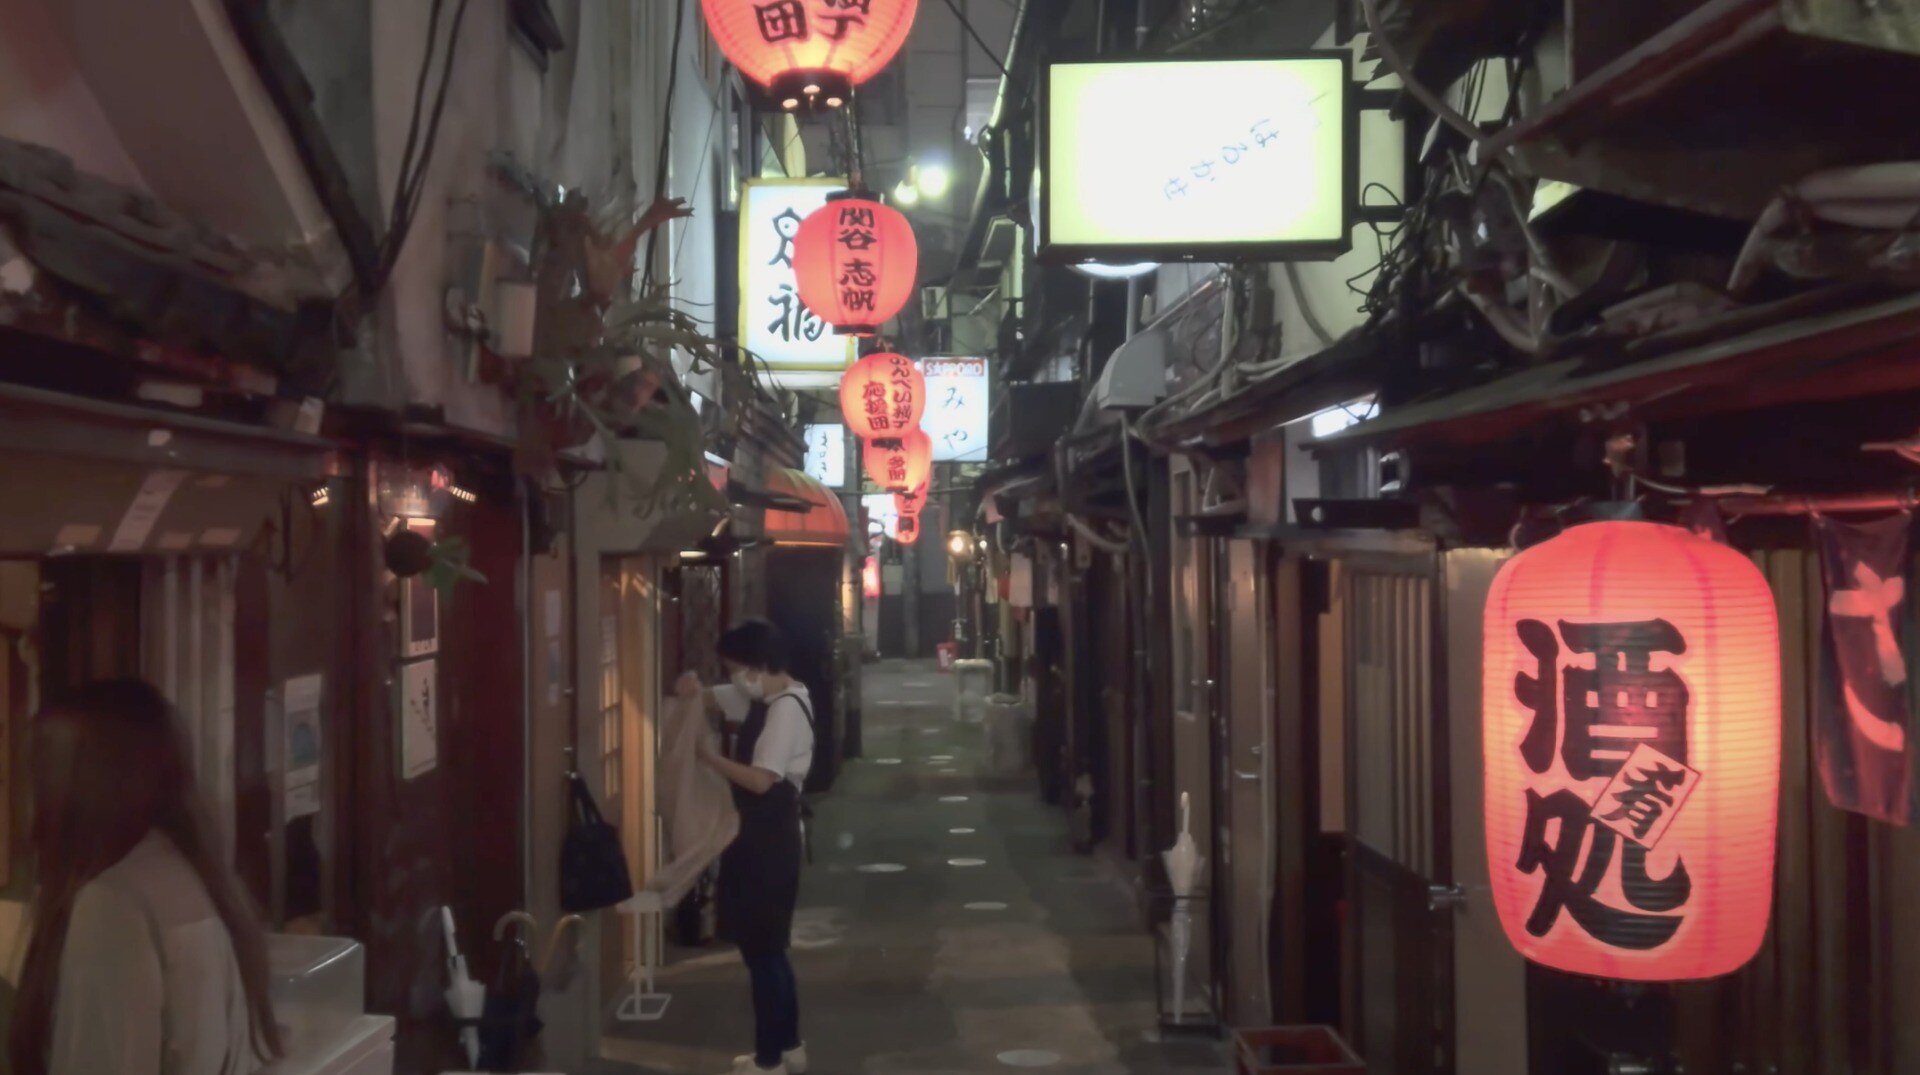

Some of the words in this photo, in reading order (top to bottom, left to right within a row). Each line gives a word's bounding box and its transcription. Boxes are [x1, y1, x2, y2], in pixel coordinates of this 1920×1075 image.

[753, 0, 808, 42] 団
[926, 361, 983, 376] SAPPORO
[1515, 618, 1692, 950] 酒処
